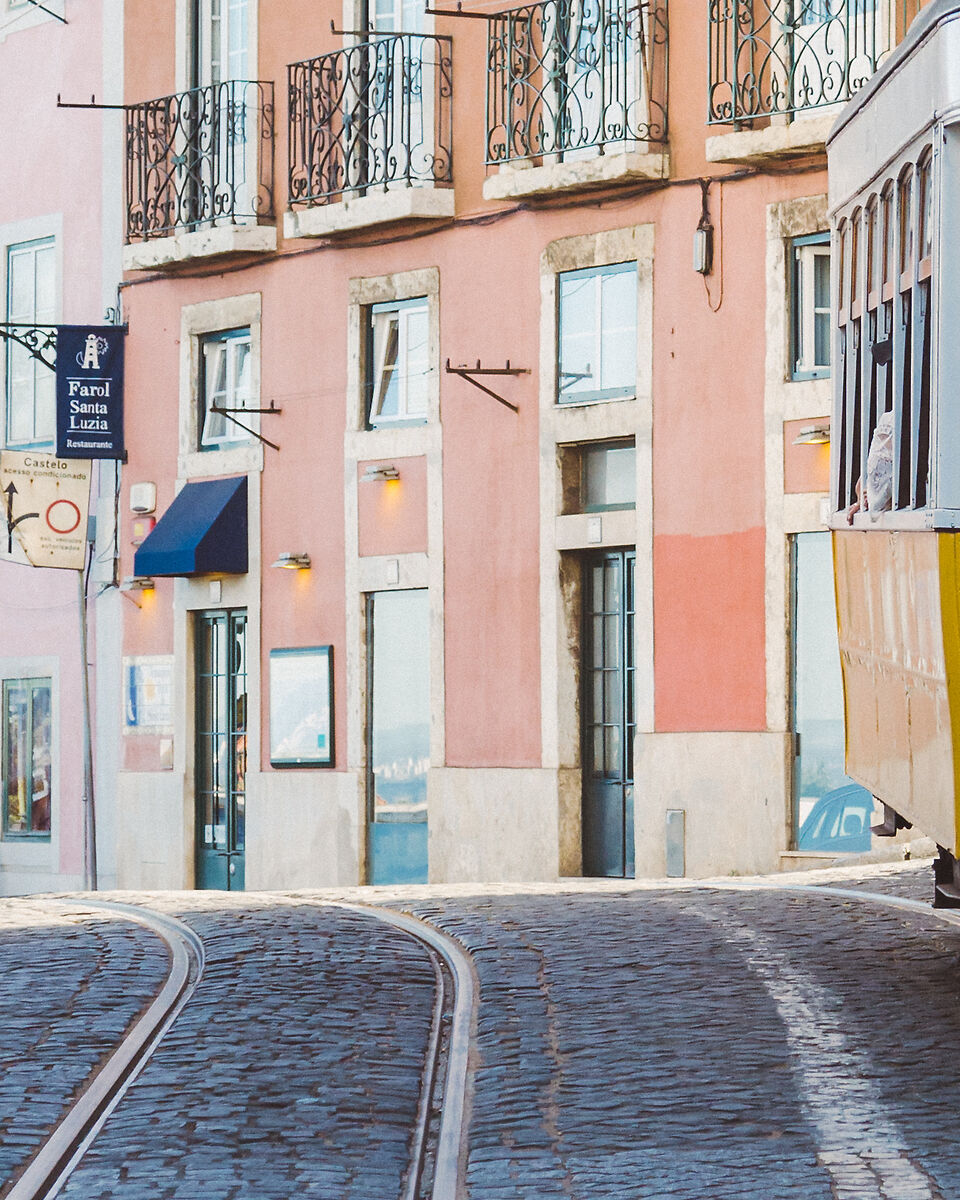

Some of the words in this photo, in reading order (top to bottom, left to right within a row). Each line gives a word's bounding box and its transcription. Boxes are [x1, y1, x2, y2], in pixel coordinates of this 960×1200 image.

[68, 381, 110, 397] Farol
[69, 399, 108, 414] Santa
[69, 415, 108, 430] Luzia
[66, 438, 113, 449] Restaurante
[24, 457, 68, 469] Castelo
[4, 468, 31, 476] acesso
[33, 470, 87, 481] condicionado
